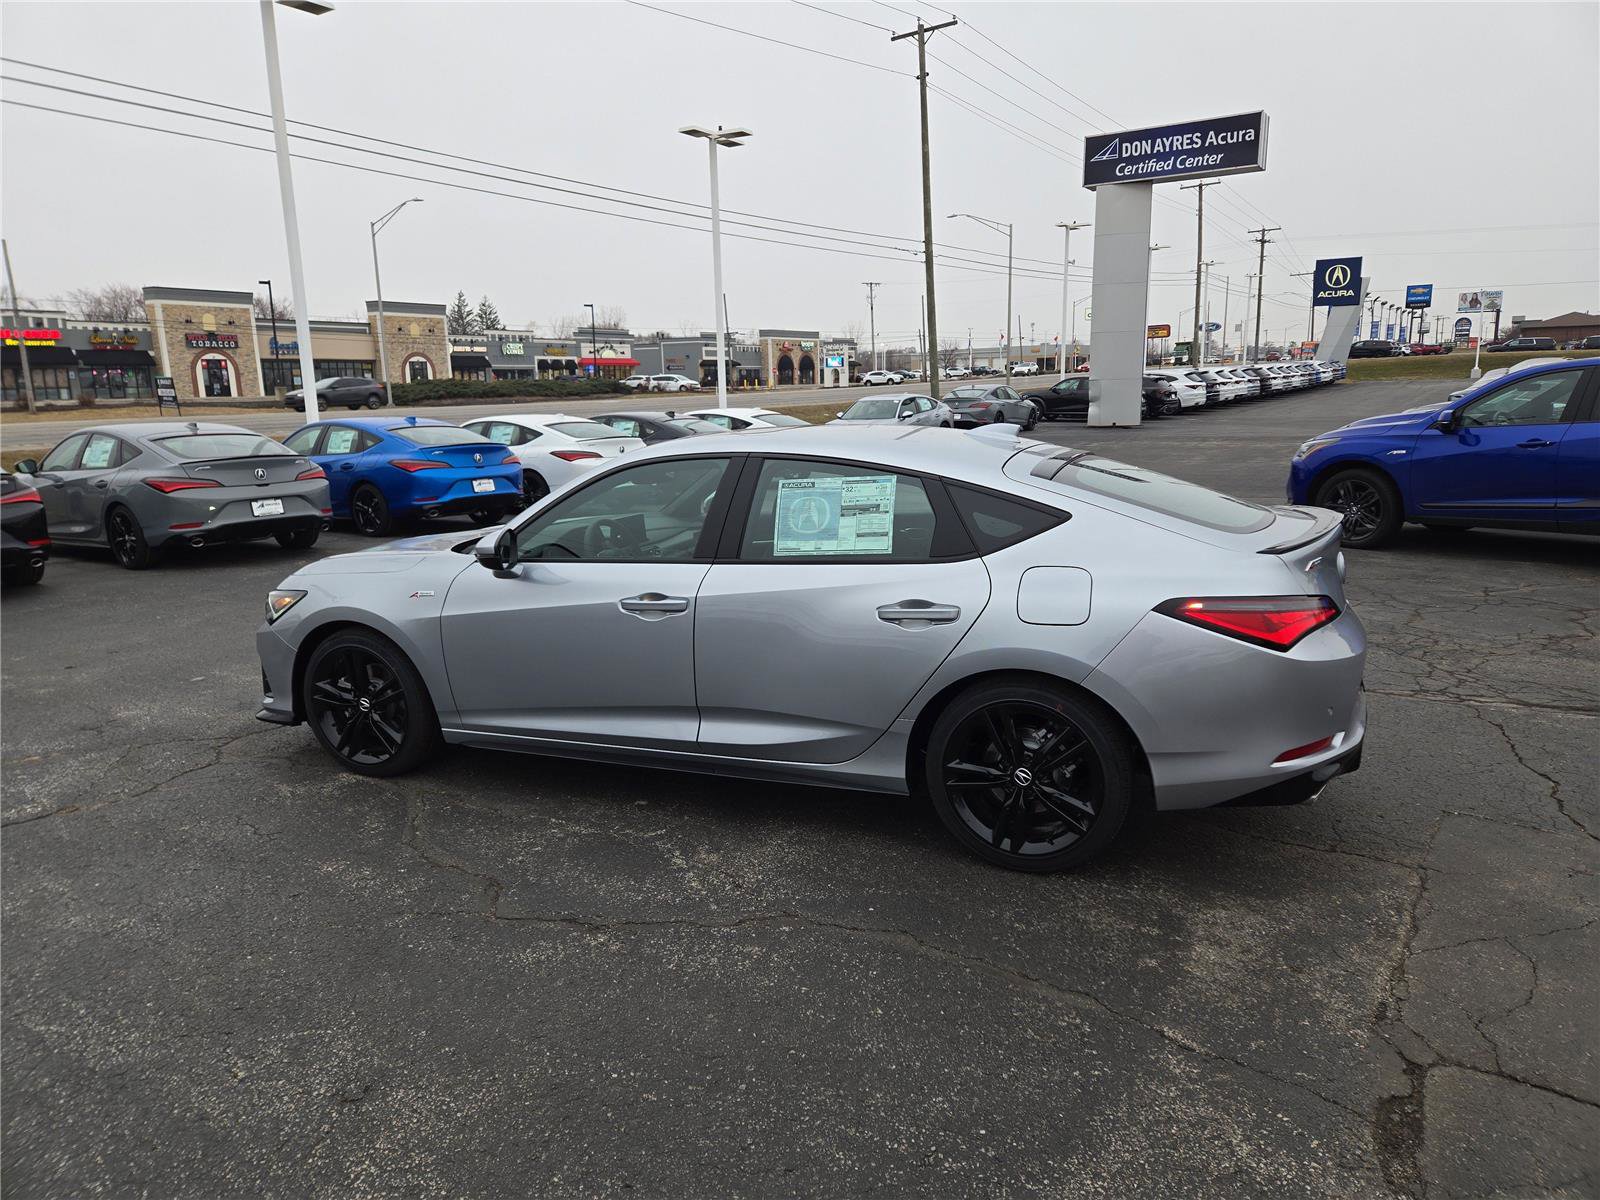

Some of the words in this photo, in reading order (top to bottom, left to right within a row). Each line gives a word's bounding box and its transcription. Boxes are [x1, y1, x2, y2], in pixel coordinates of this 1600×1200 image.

[1122, 139, 1152, 158] DON
[1154, 133, 1202, 155] AYRES
[1205, 128, 1255, 147] Acura
[1116, 156, 1174, 177] Certified
[1176, 153, 1224, 170] Center
[1317, 289, 1355, 298] ACURA
[5, 338, 56, 346] Resaurant
[191, 340, 235, 348] TOBACCO
